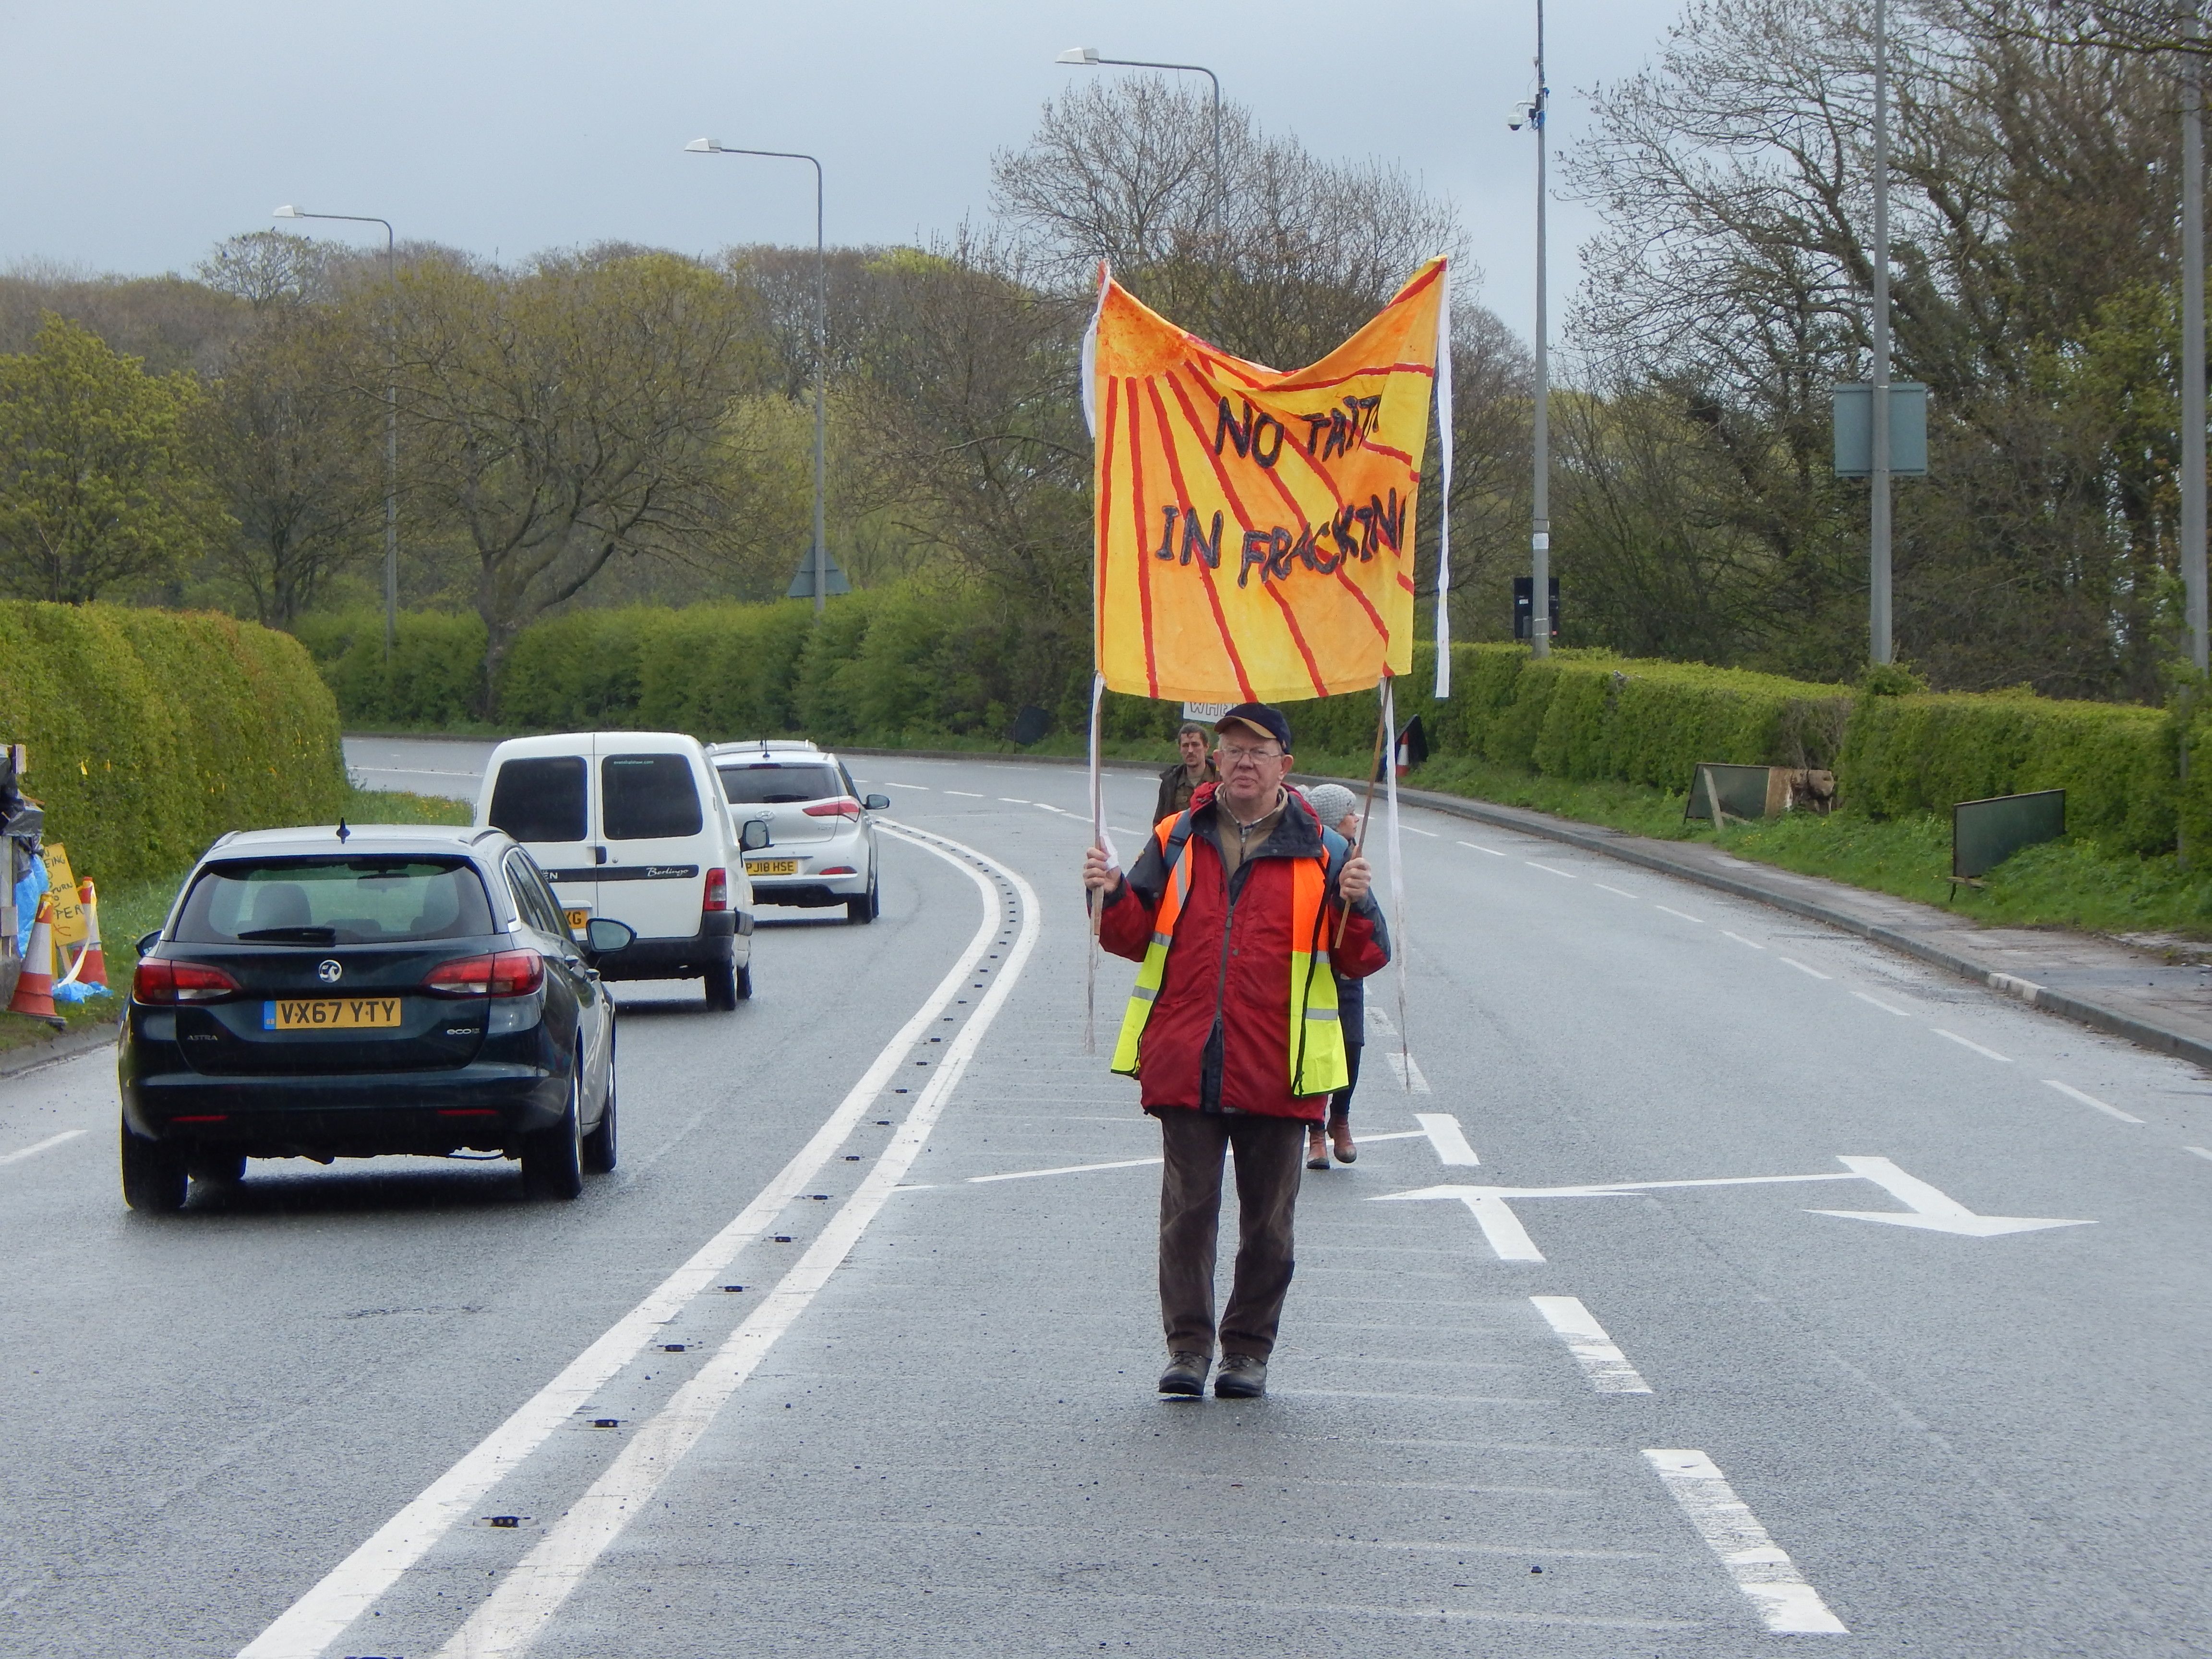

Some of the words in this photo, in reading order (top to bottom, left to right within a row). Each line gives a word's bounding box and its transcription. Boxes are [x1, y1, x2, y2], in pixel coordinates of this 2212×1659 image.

[1214, 396, 1284, 468] NO
[1155, 505, 1224, 569] IN
[1190, 702, 1241, 717] WHE
[44, 854, 65, 868] EING
[745, 862, 769, 872] PJ18
[773, 862, 794, 872] HSE
[646, 867, 689, 877] Berlingo
[54, 903, 84, 920] PER
[281, 1002, 342, 1023] VX67
[350, 1001, 395, 1022] YTY
